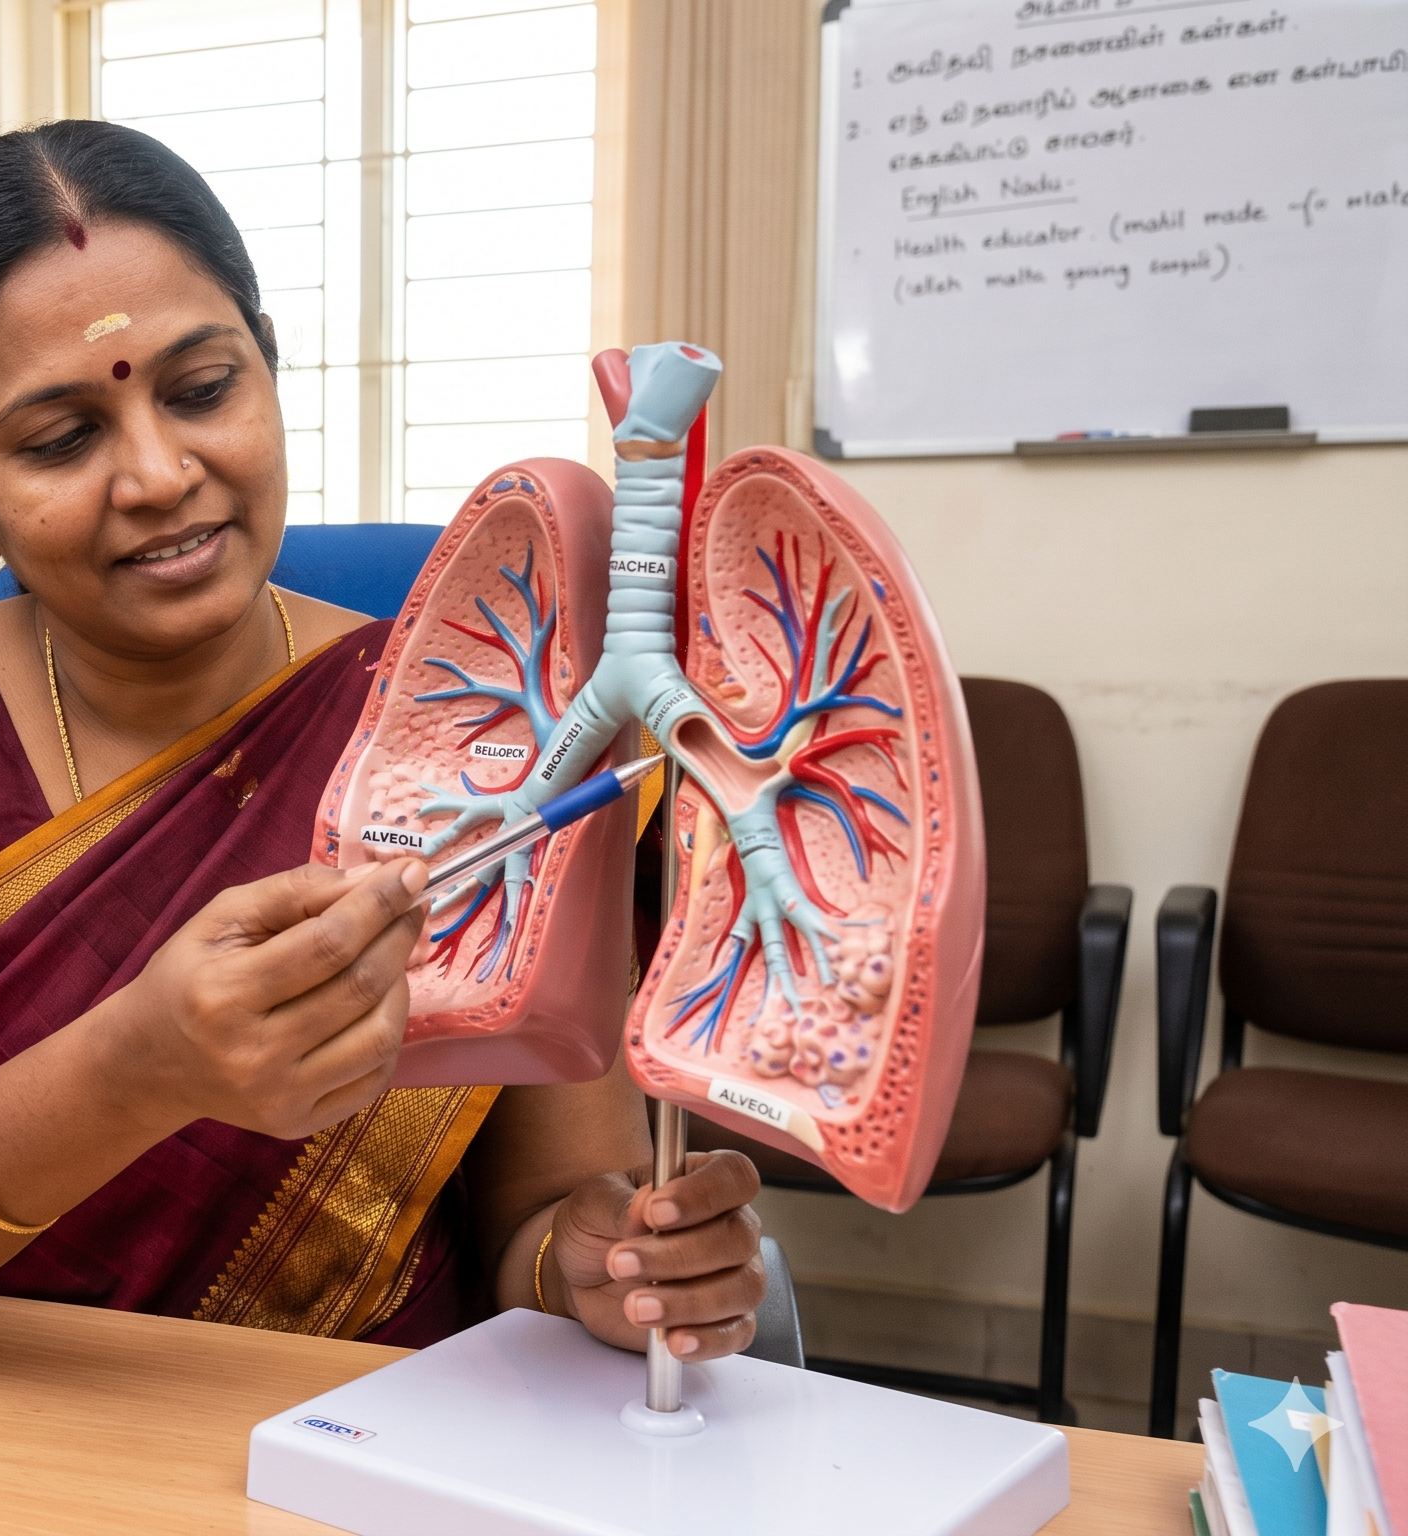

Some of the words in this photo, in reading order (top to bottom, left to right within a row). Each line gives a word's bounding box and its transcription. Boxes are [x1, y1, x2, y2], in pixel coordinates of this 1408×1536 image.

[901, 182, 979, 216] English
[894, 231, 967, 260] Health
[1203, 199, 1269, 226] made
[361, 829, 423, 849] ALVEOLI
[719, 1089, 782, 1121] ALVEOLI
